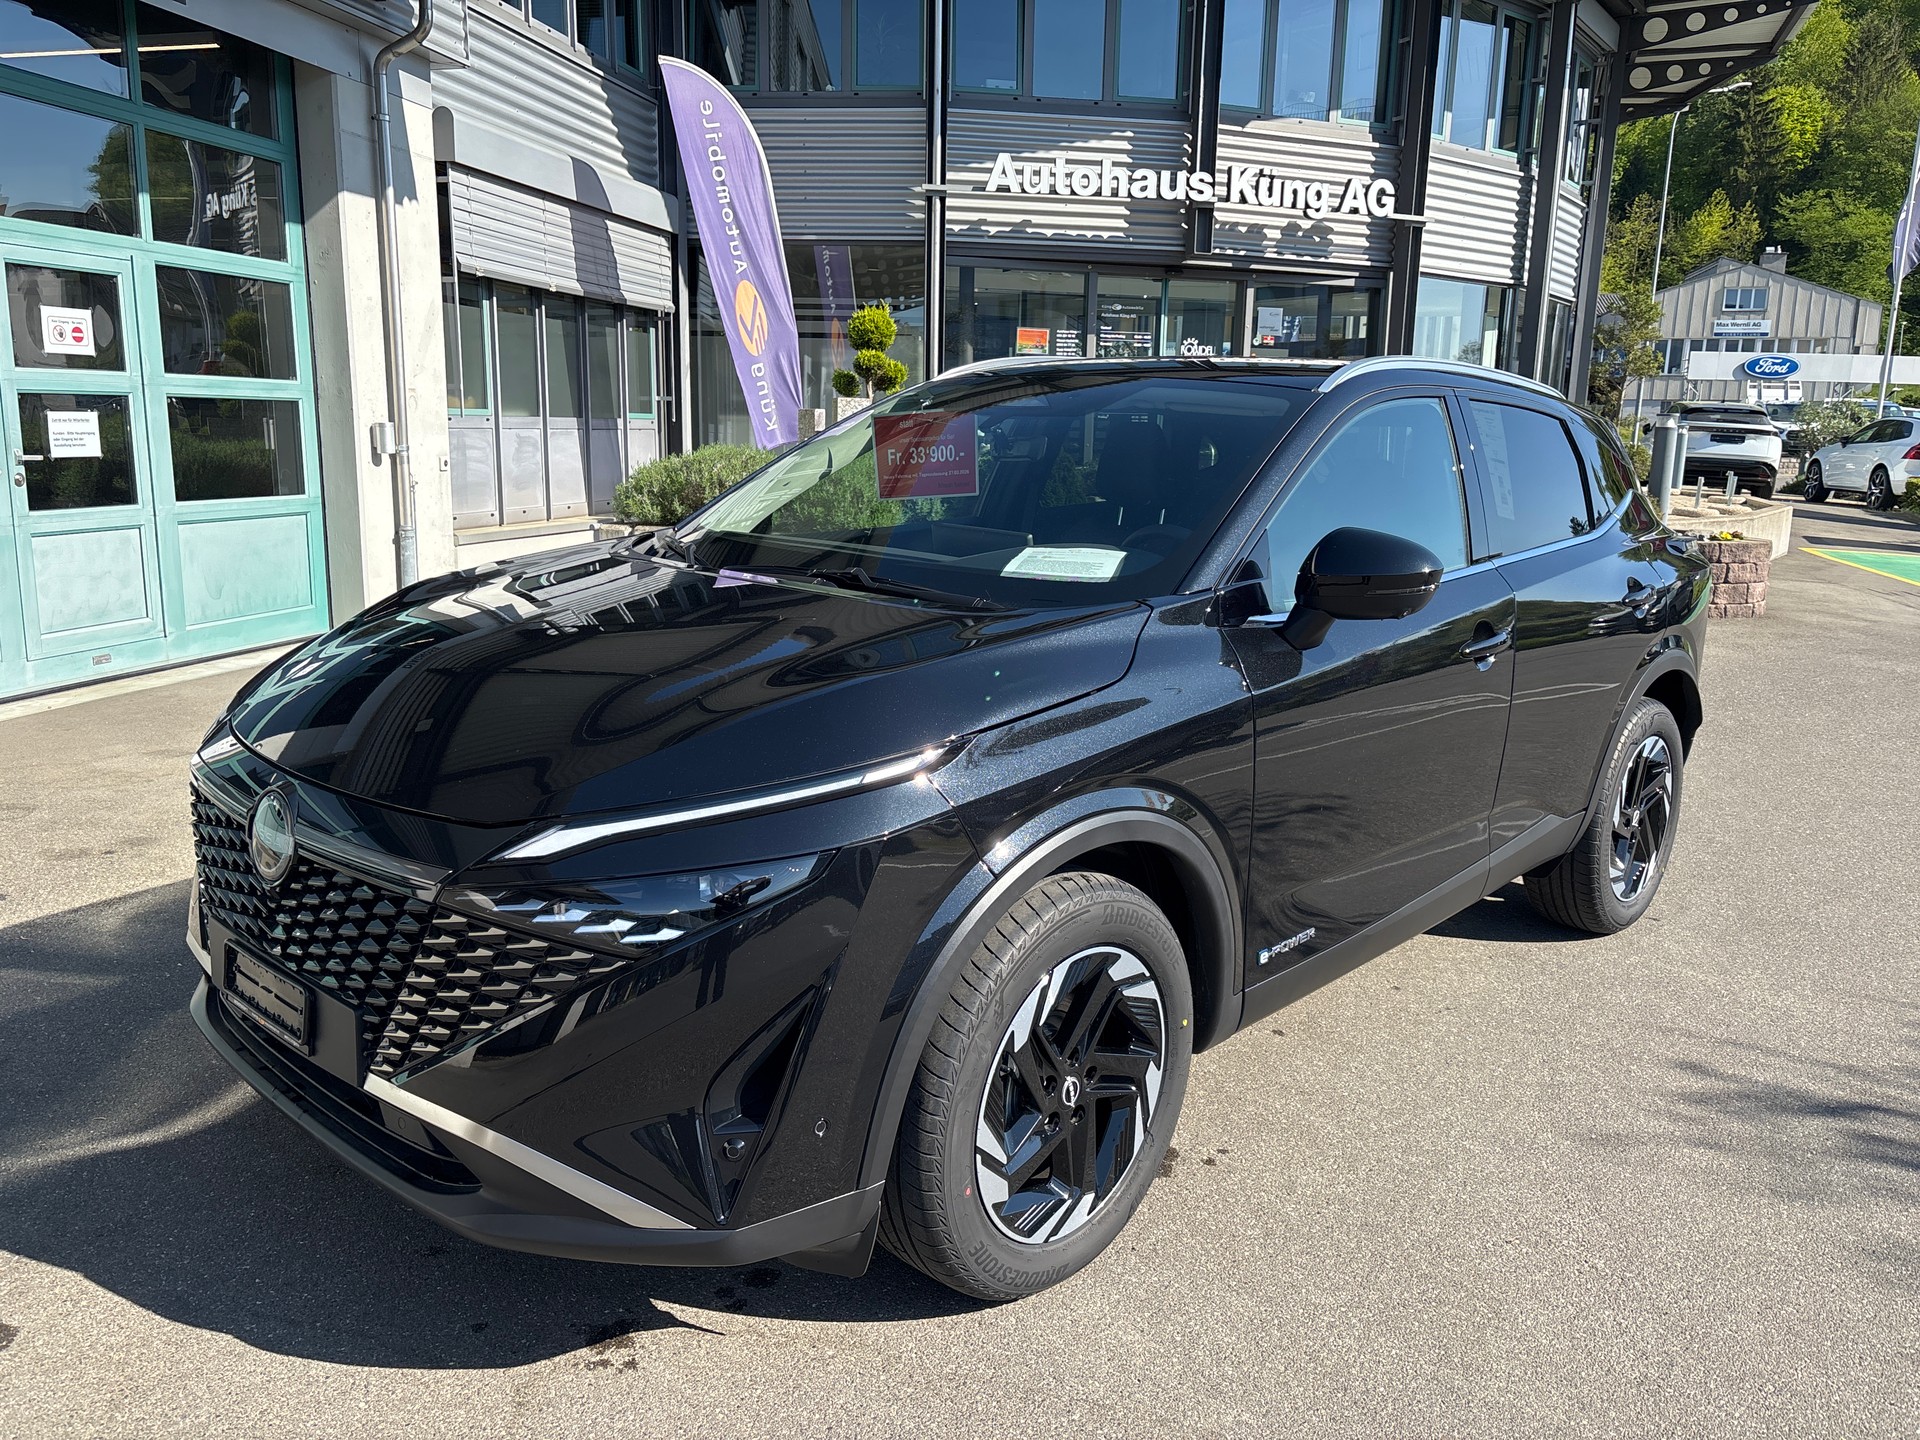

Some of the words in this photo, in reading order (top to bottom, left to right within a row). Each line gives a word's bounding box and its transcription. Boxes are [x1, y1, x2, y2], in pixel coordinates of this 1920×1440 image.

[985, 153, 1214, 202] Autohaus
[1229, 165, 1331, 218] Küng
[1341, 178, 1396, 217] AG
[1755, 358, 1790, 373] Ford
[887, 448, 906, 466] Fr.
[1101, 904, 1183, 972] BRIDGESTONE
[1258, 926, 1317, 966] e-POWER
[967, 1239, 1070, 1289] BRIDGESTONE
